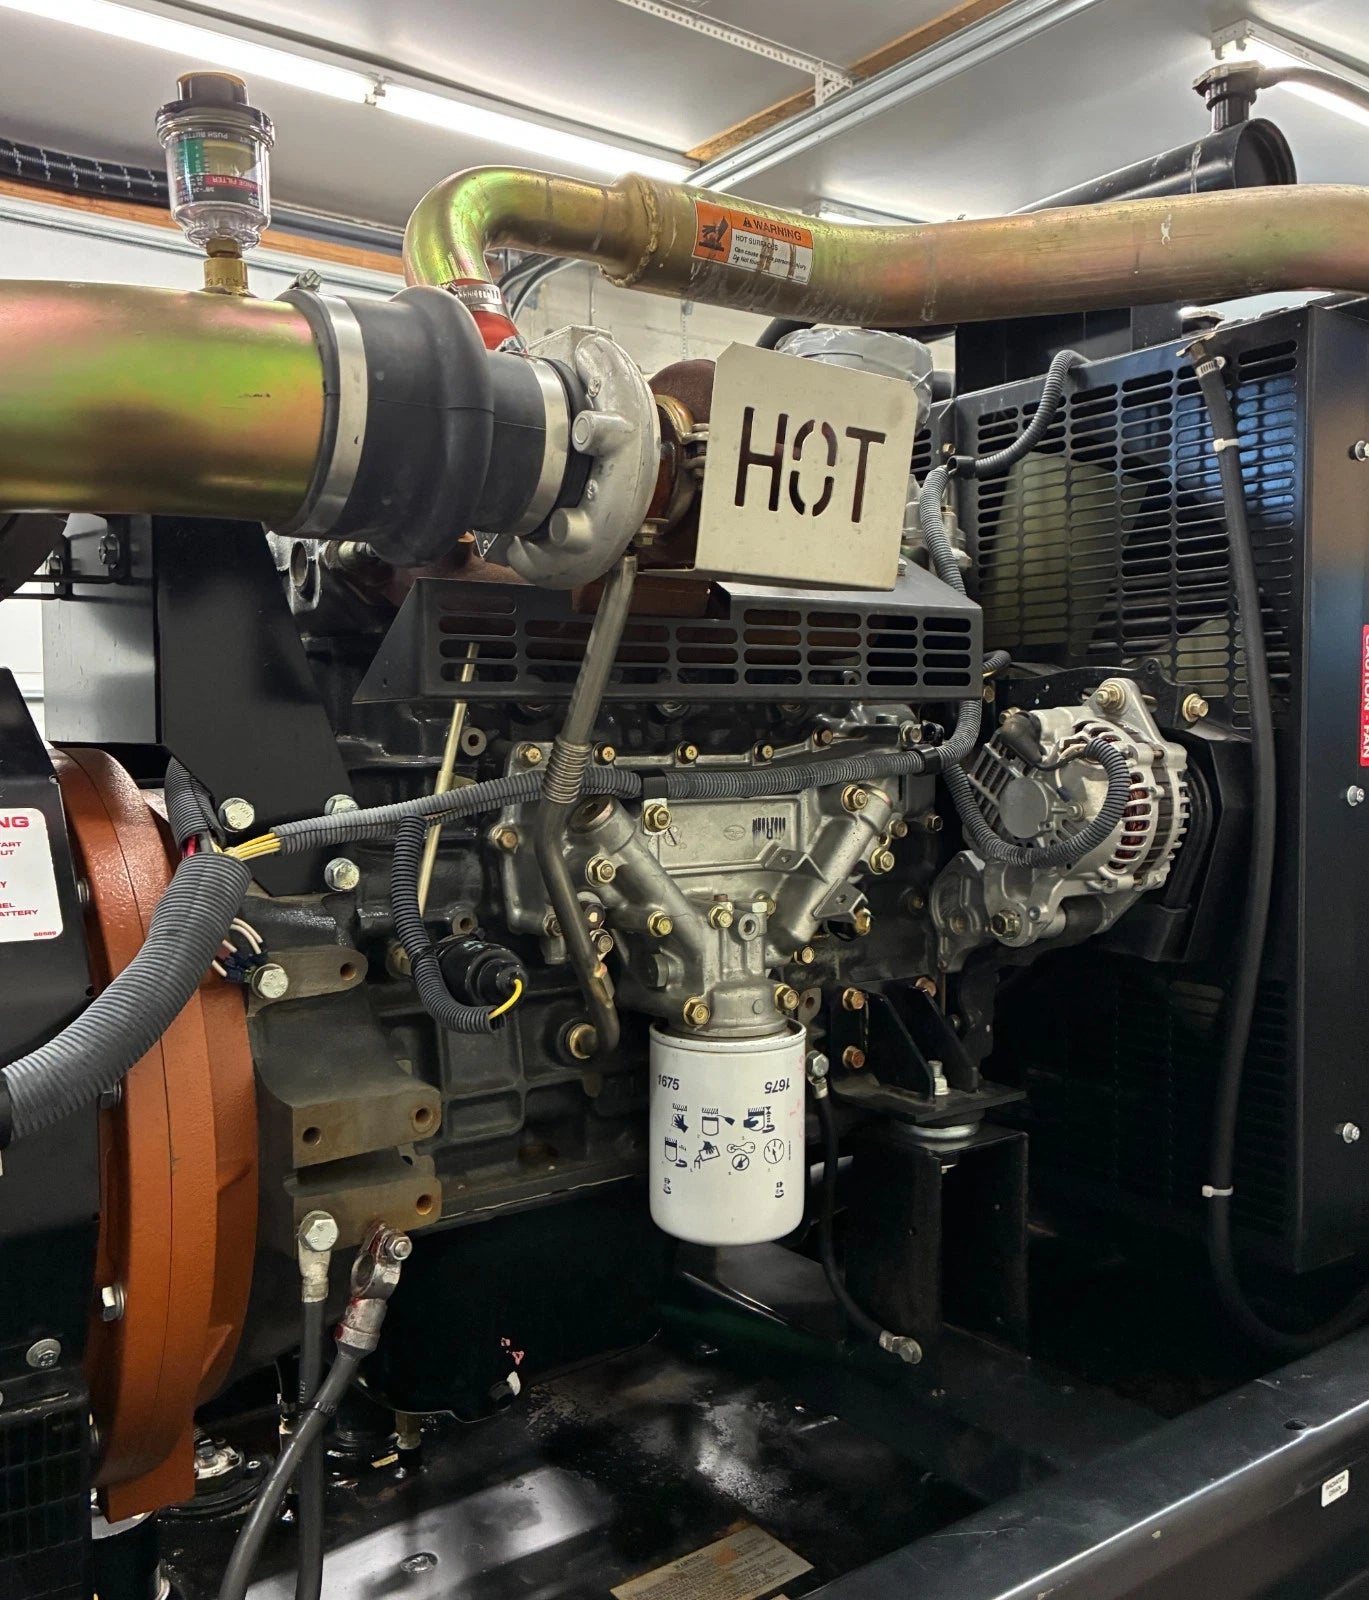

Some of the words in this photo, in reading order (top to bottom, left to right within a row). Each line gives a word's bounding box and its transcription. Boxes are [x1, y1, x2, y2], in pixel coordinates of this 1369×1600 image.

[212, 176, 238, 185] FILTER
[735, 234, 748, 243] HOT
[753, 219, 802, 241] WARNING
[734, 406, 887, 523] HOT
[657, 1074, 680, 1091] 1675
[764, 1077, 791, 1094] 1675
